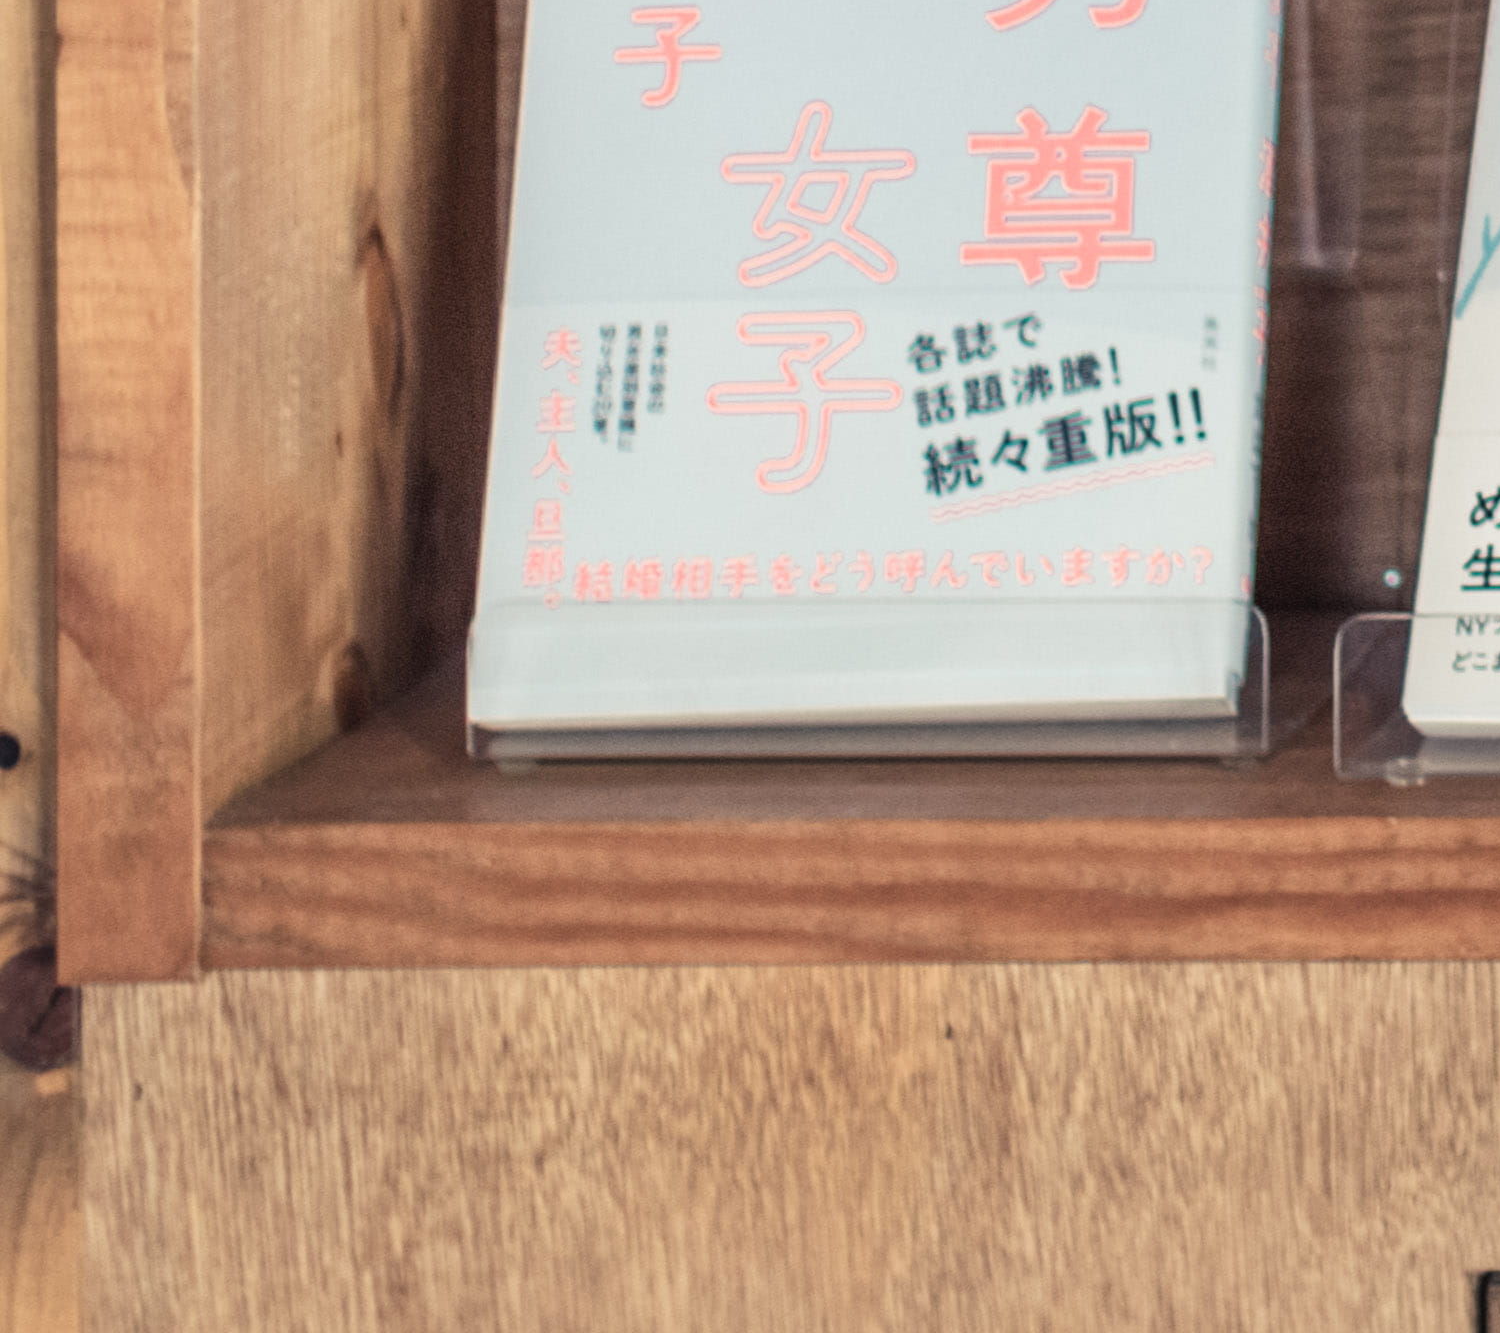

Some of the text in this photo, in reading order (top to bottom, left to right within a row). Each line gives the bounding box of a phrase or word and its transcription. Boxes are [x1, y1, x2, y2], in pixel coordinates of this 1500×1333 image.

[705, 99, 919, 494] 女子
[908, 313, 1044, 375] 各誌で
[522, 325, 582, 610] 夫、主人、旦那。
